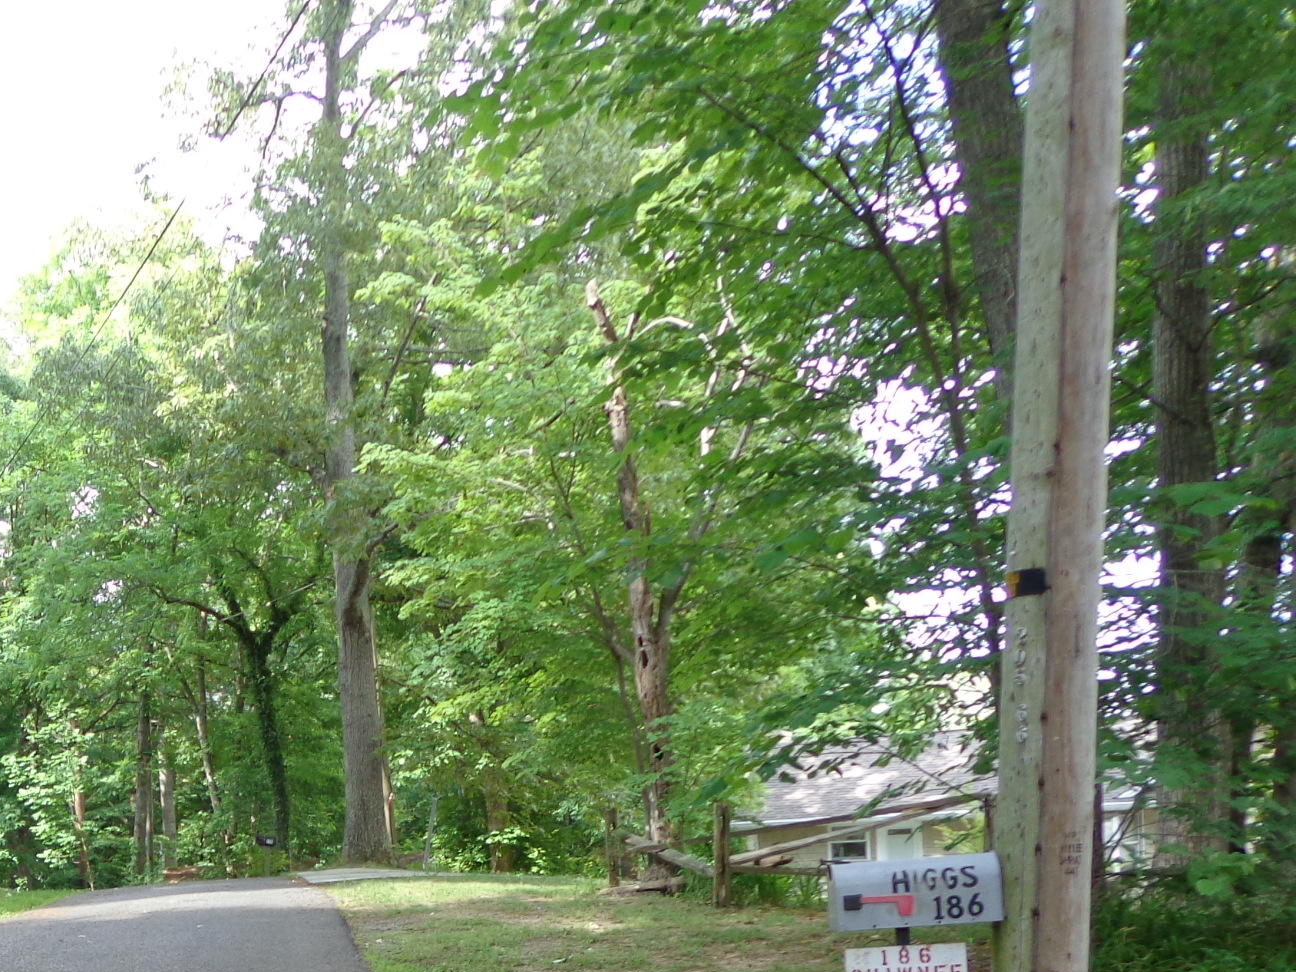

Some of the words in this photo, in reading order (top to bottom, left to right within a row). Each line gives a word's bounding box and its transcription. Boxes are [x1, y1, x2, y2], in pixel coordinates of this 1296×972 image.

[892, 865, 979, 893] HIGGS
[933, 893, 984, 920] 186
[881, 946, 932, 966] 186
